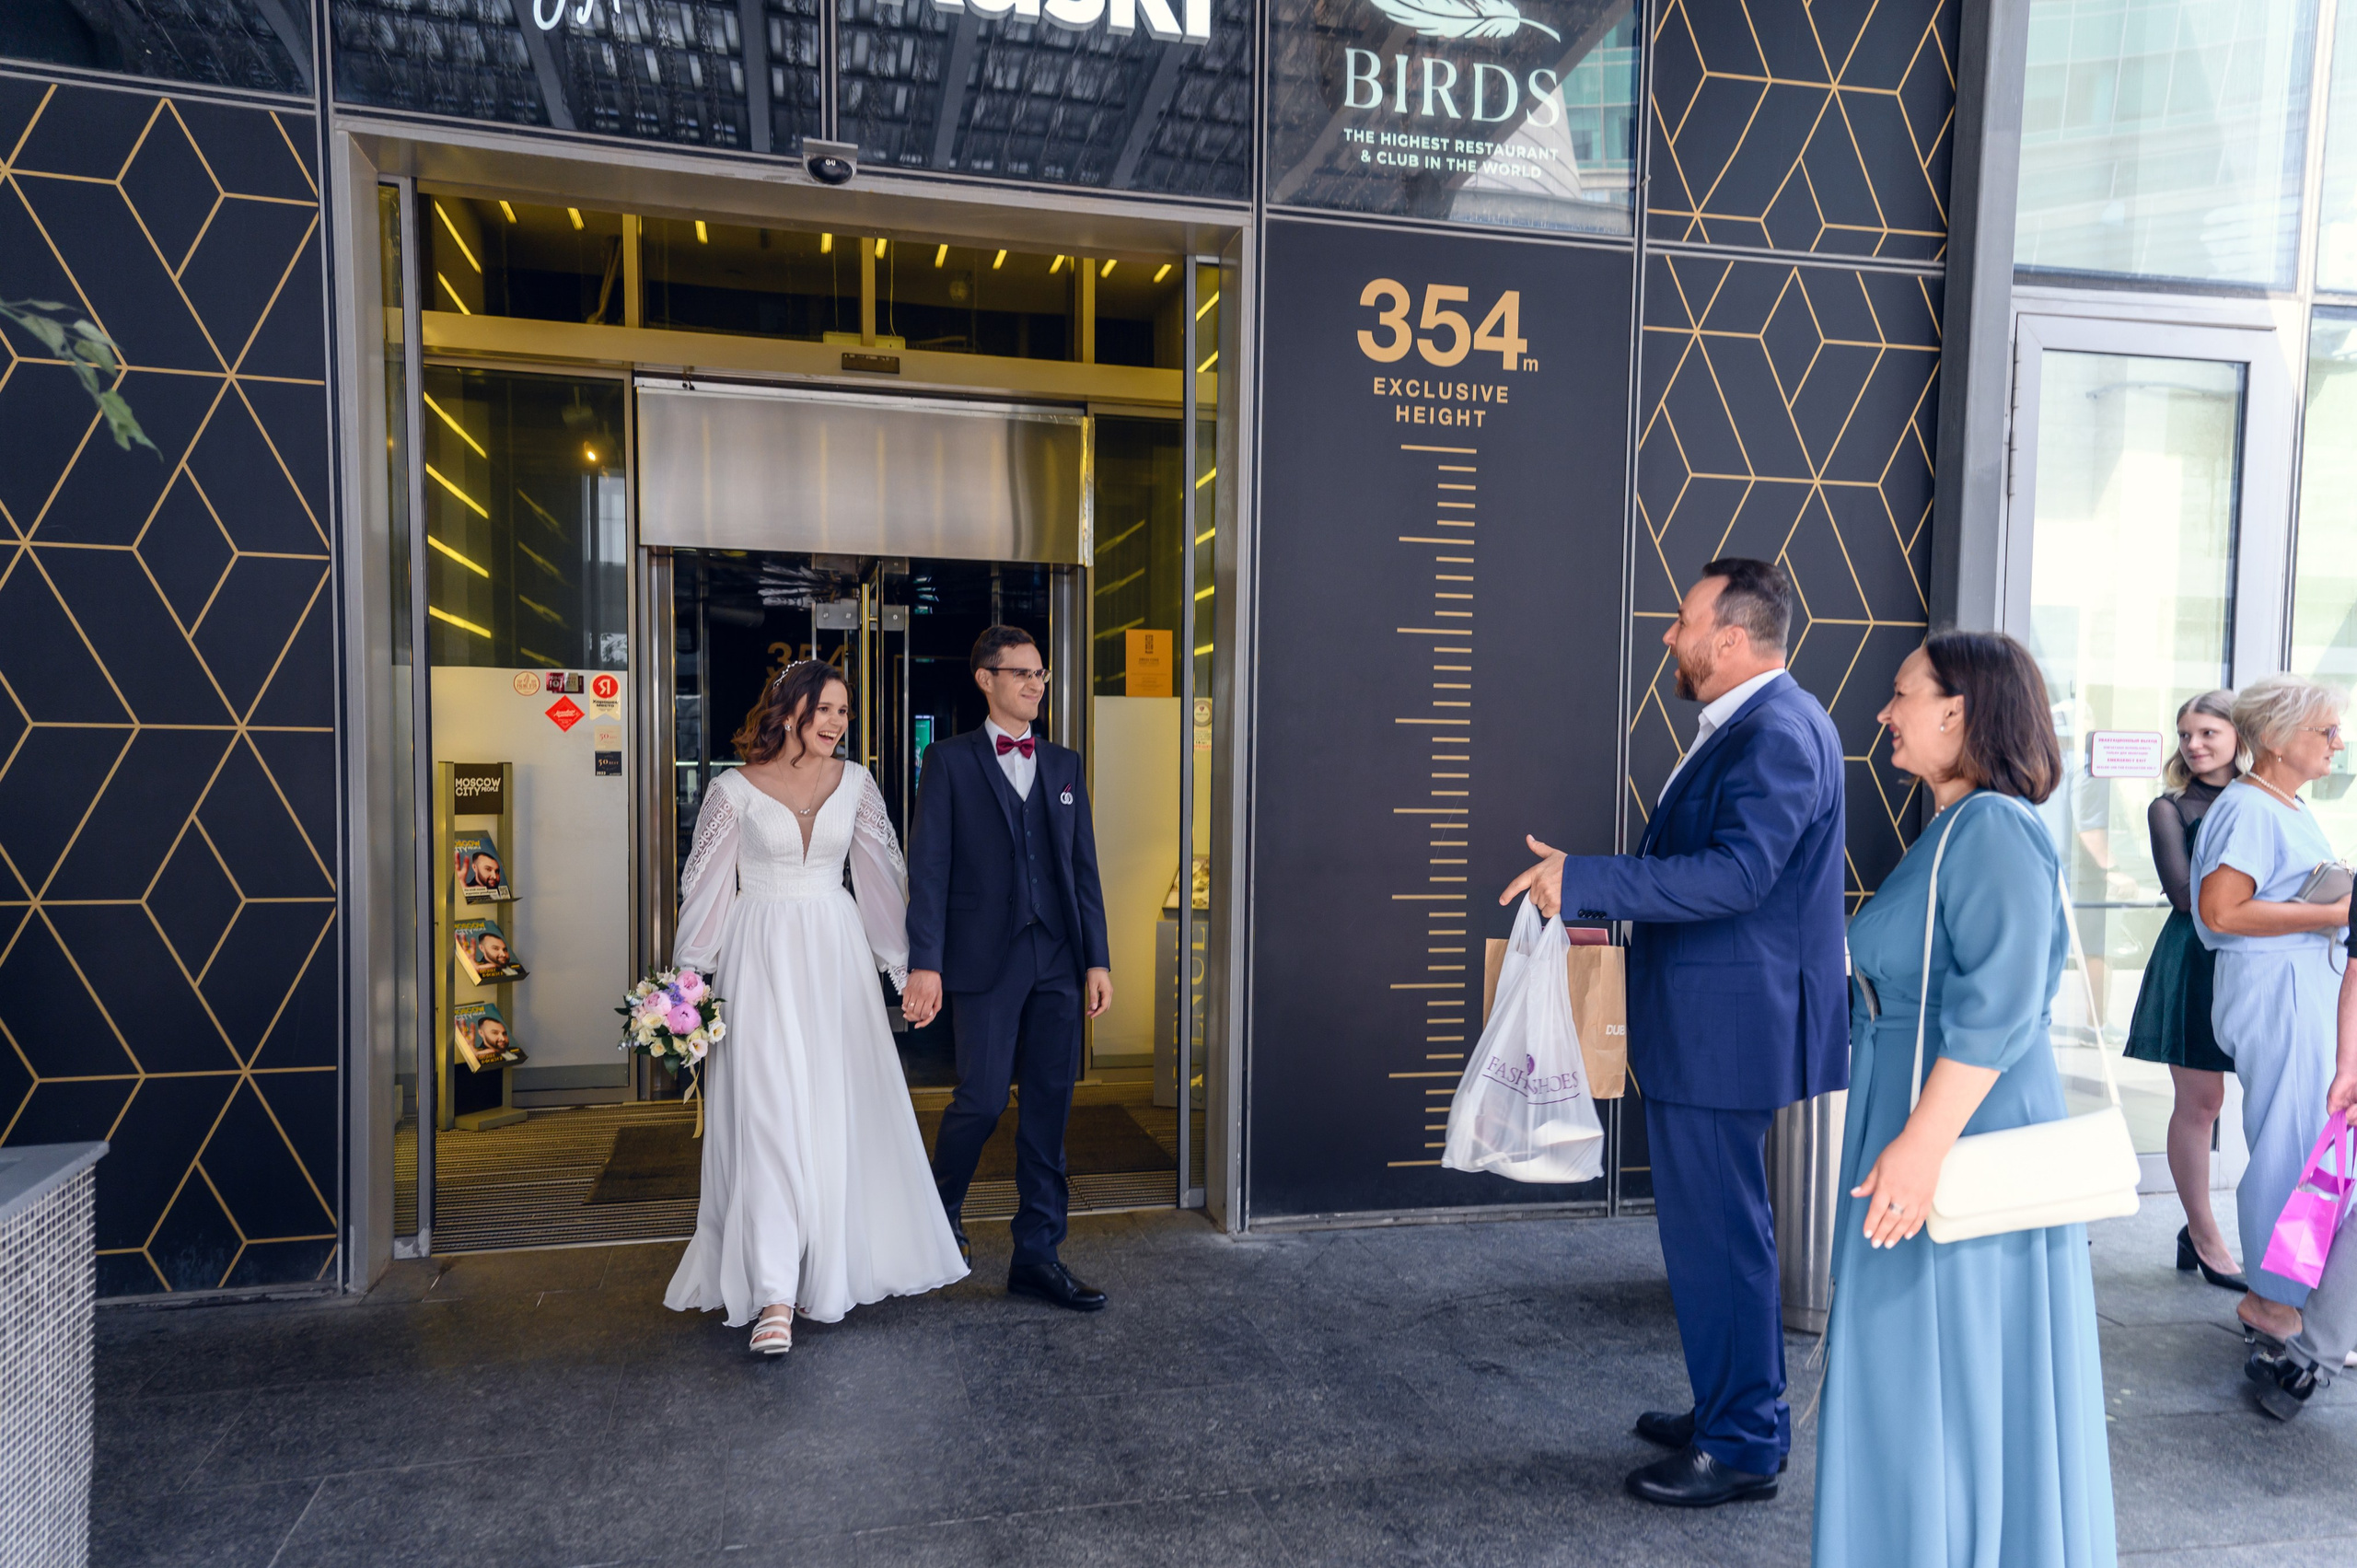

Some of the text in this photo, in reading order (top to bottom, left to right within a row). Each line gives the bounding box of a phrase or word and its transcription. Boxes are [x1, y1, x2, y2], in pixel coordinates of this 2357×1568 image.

[1344, 48, 1561, 127] BIRDS
[1343, 128, 1559, 161] THE HIGHEST RESTAURANT
[1361, 149, 1542, 179] & CLUB IN THE WORLD
[1357, 278, 1527, 371] 354
[1373, 377, 1509, 403] EXCLUSIVE
[1396, 404, 1486, 427] HEIGHT
[455, 777, 501, 787] MOSCOW
[455, 786, 481, 796] CITY
